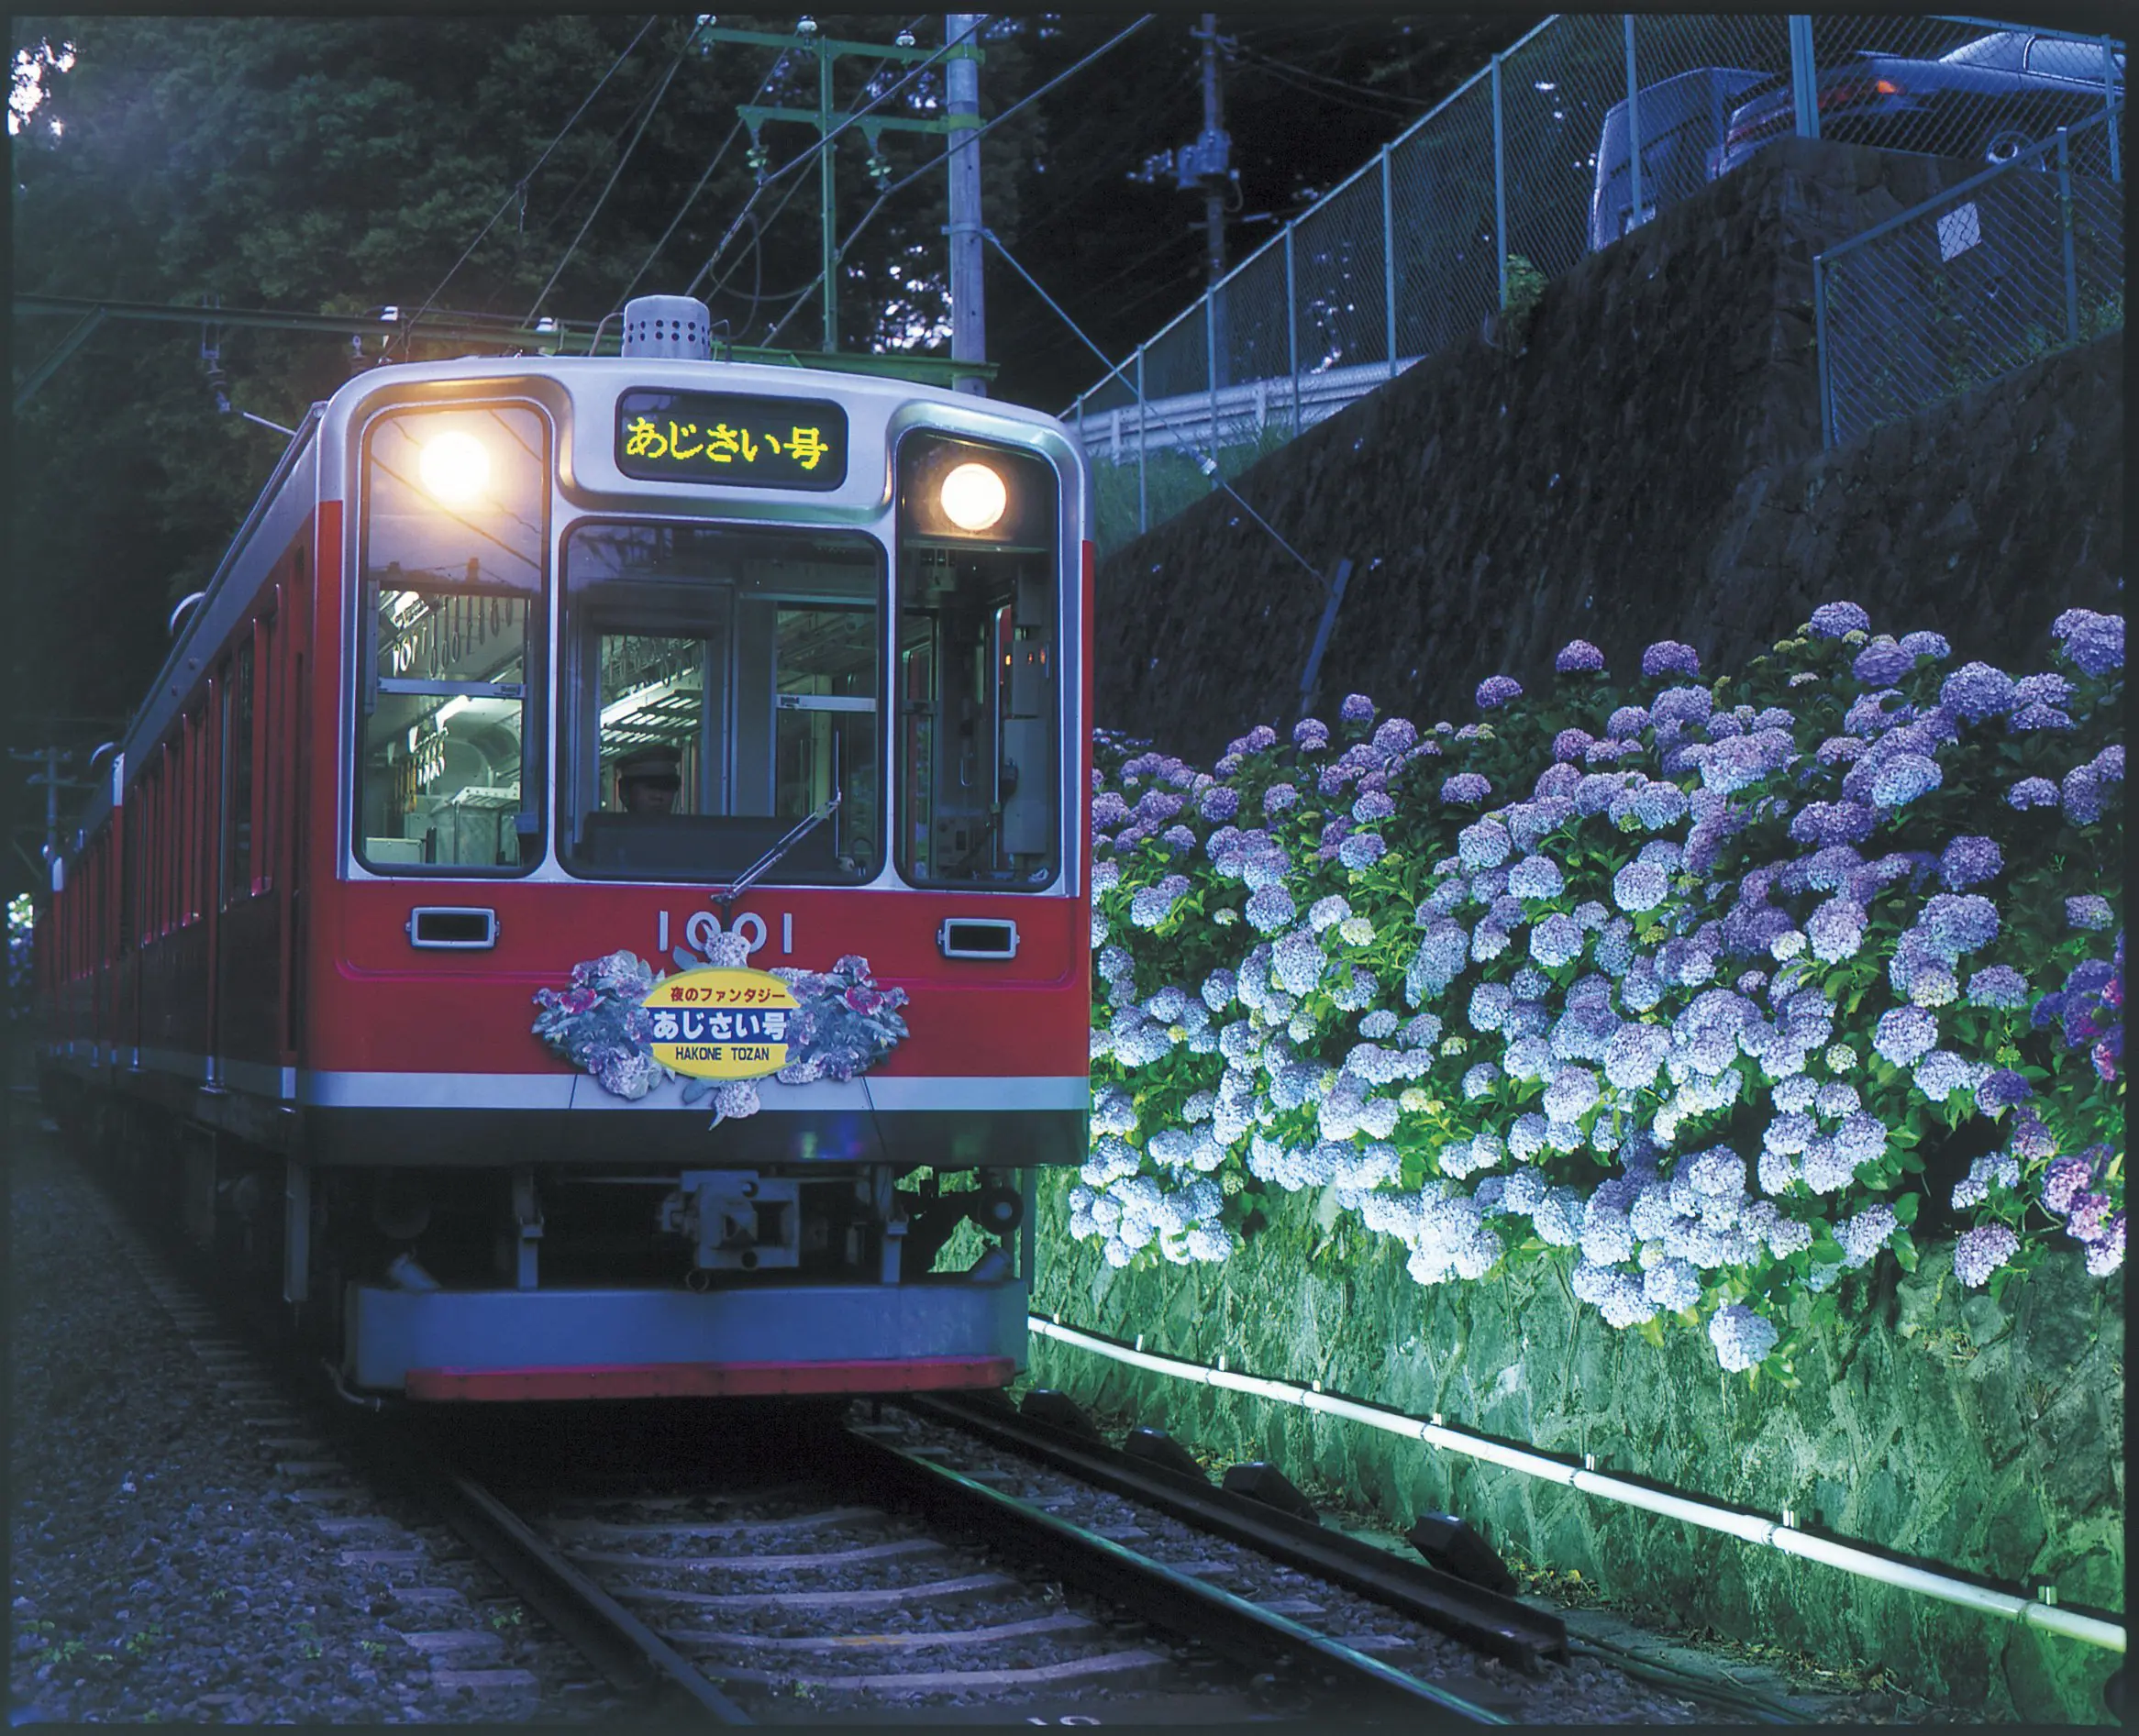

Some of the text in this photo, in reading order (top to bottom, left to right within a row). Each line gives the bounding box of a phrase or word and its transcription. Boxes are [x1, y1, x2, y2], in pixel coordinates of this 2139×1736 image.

[626, 416, 829, 470] あじさい号
[659, 911, 792, 954] 1001
[671, 987, 786, 1003] 夜のファンタジー
[654, 1011, 787, 1041] あじさい号
[675, 1046, 770, 1061] HAKONE TOZAN
